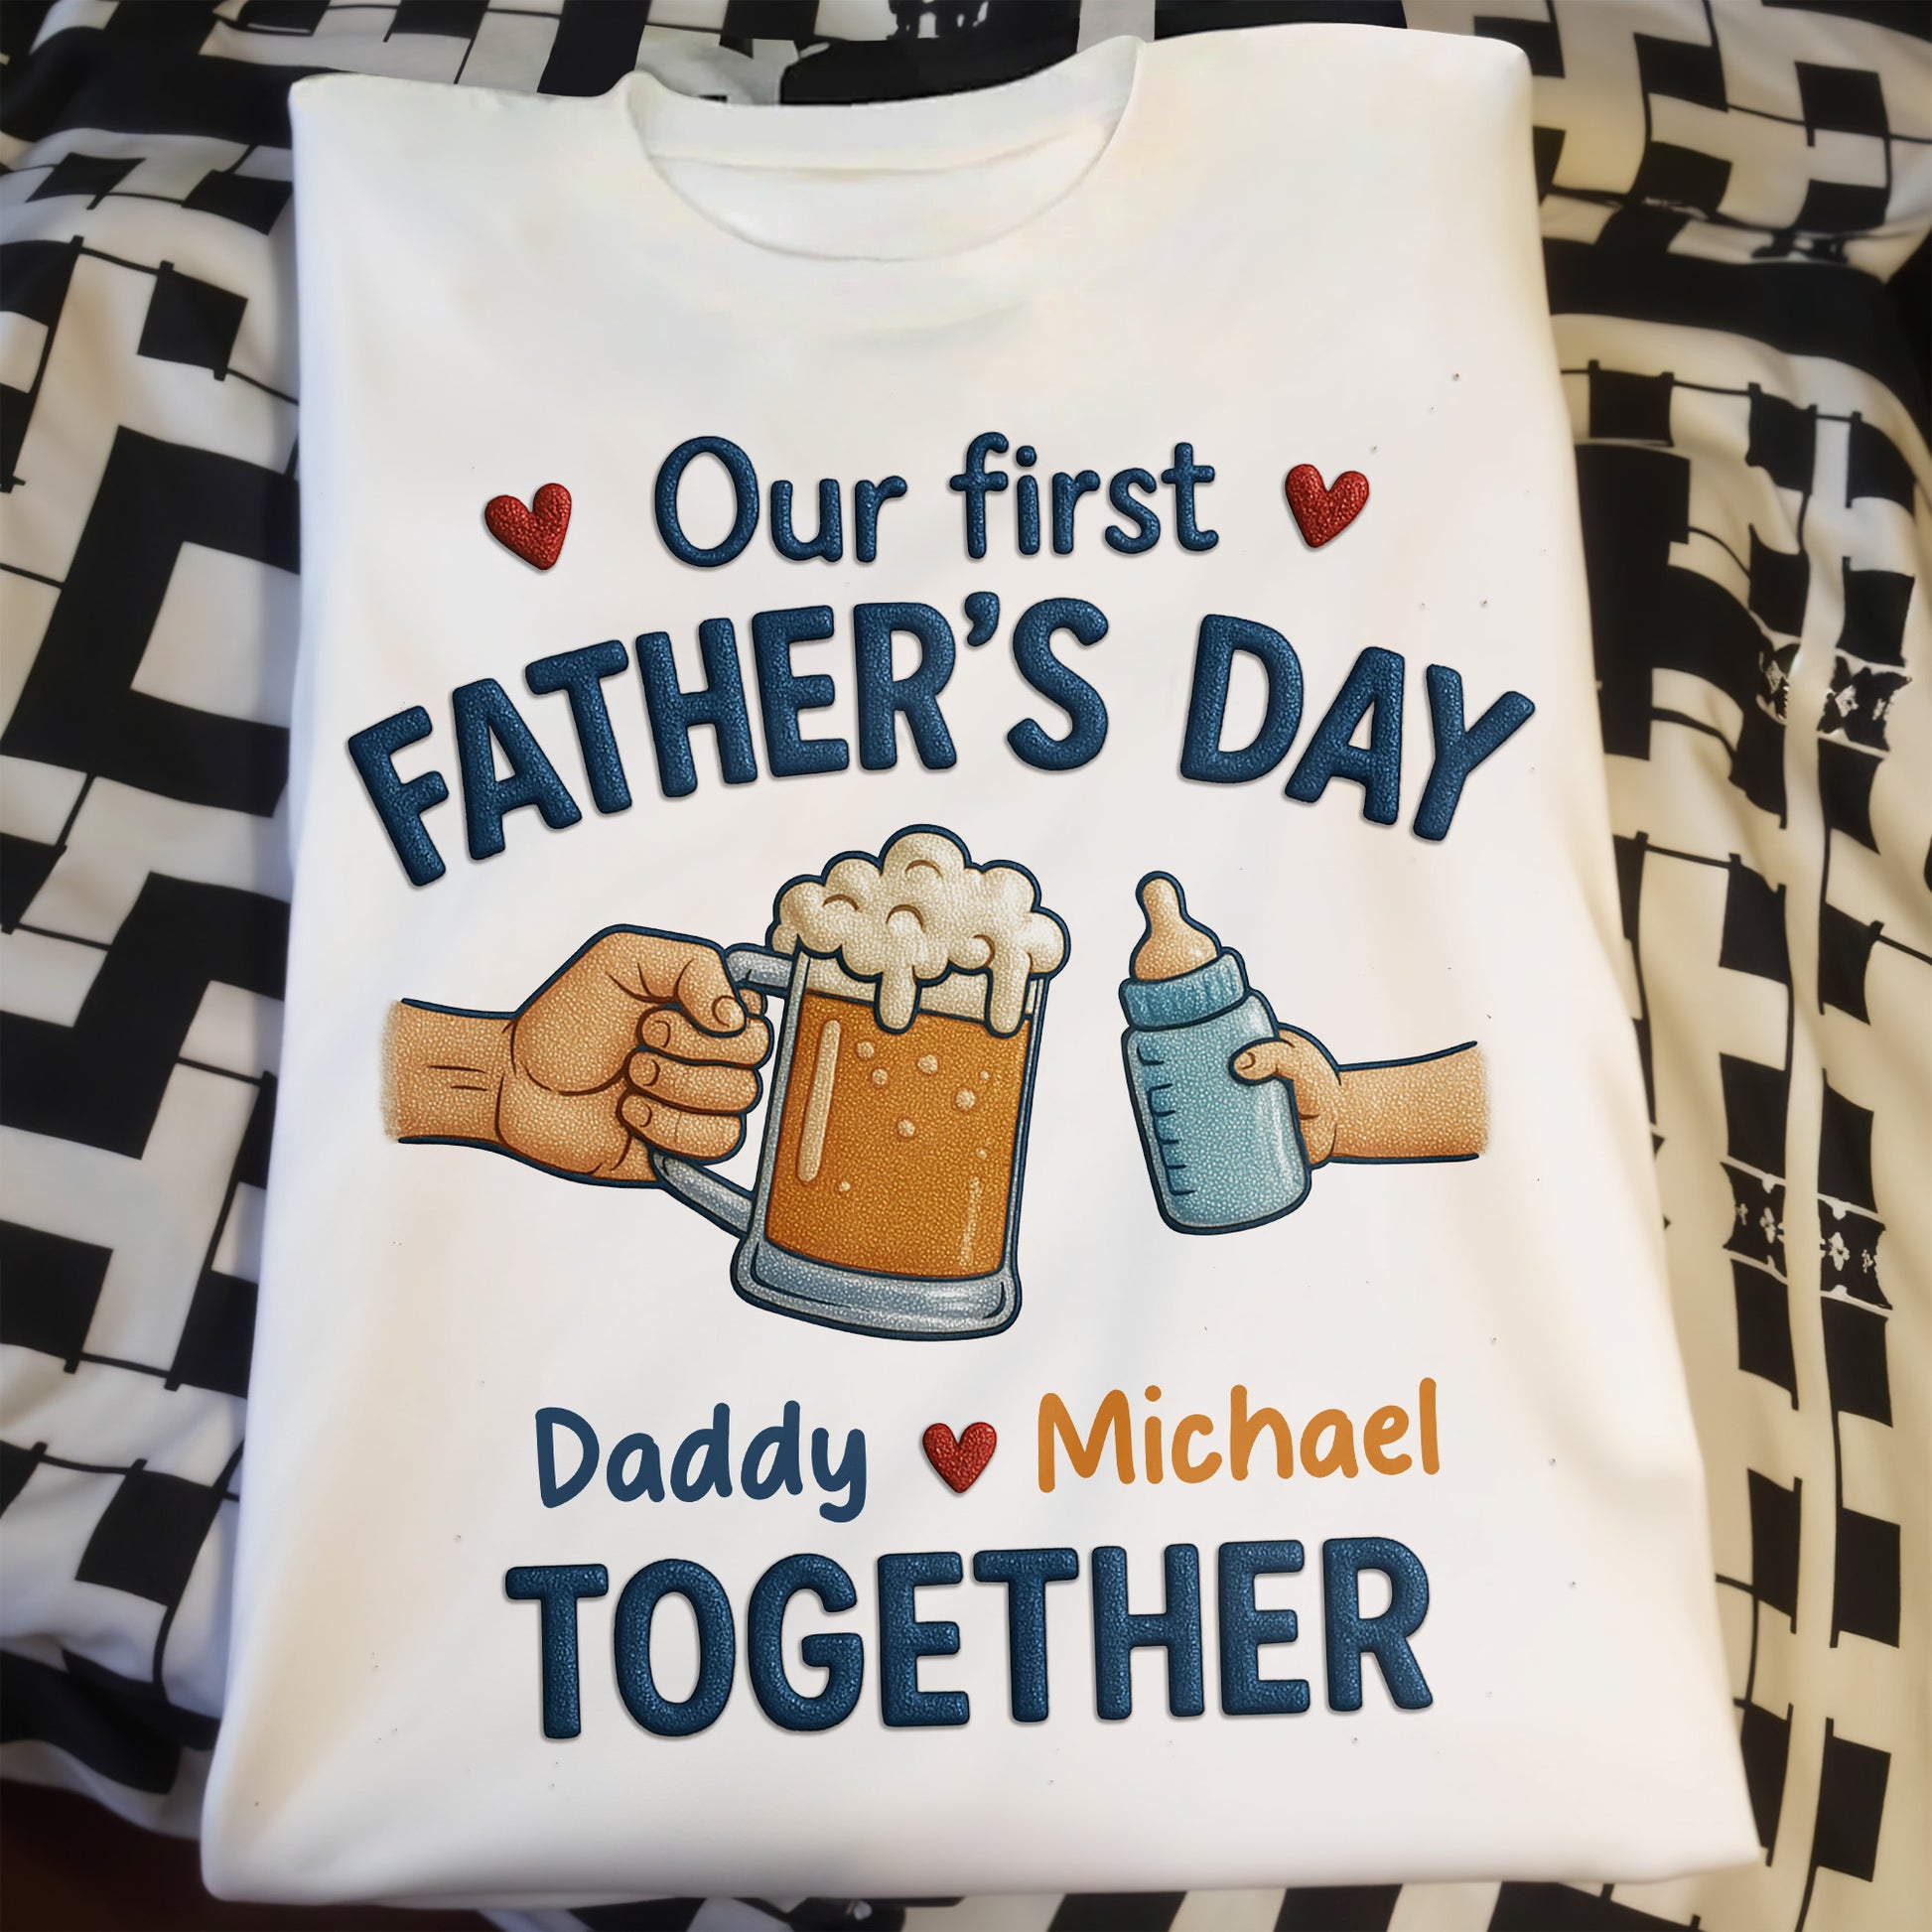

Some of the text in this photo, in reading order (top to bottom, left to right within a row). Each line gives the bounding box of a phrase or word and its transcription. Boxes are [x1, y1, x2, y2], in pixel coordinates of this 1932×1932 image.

[652, 431, 1220, 571] Our first
[345, 591, 1536, 890] FATHER'S DAY
[534, 1377, 1441, 1524] Daddy Michael
[502, 1536, 1434, 1742] TOGETHER
